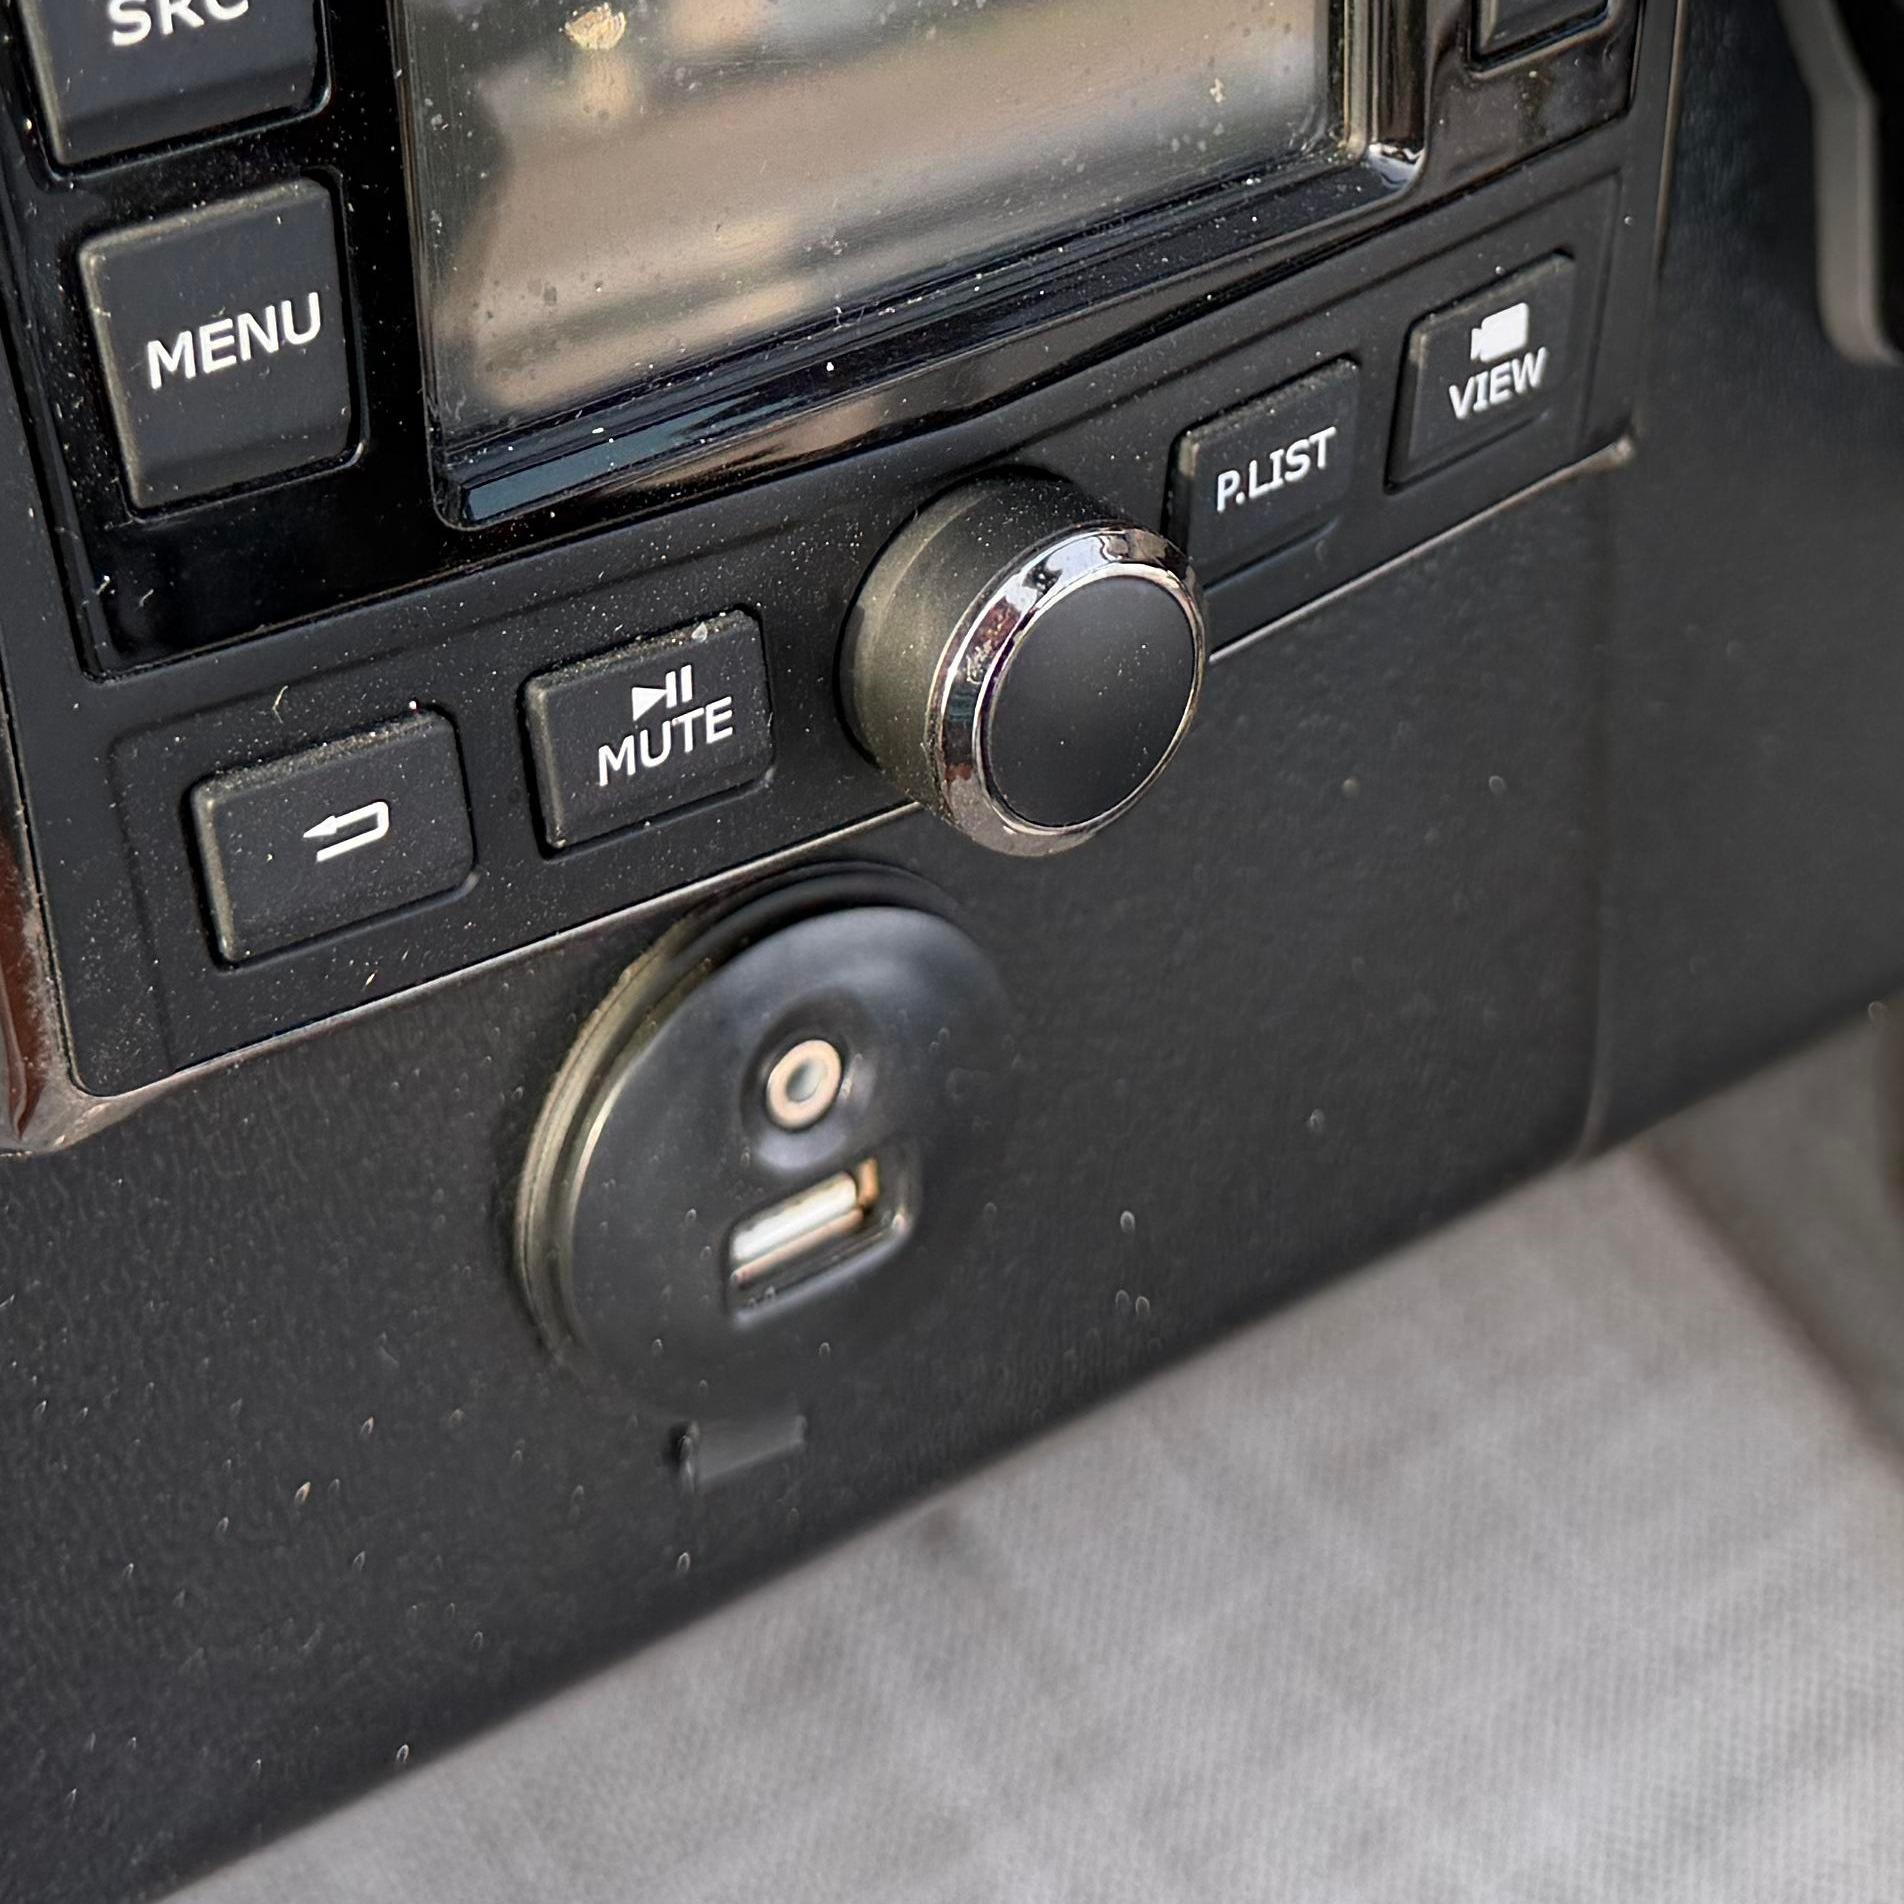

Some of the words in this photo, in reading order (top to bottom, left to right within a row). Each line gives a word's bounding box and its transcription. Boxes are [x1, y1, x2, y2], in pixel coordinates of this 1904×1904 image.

[146, 292, 322, 391] MENU
[1448, 346, 1548, 420] VIEW
[1216, 425, 1337, 513] P.LIST
[597, 696, 734, 787] MUTE
